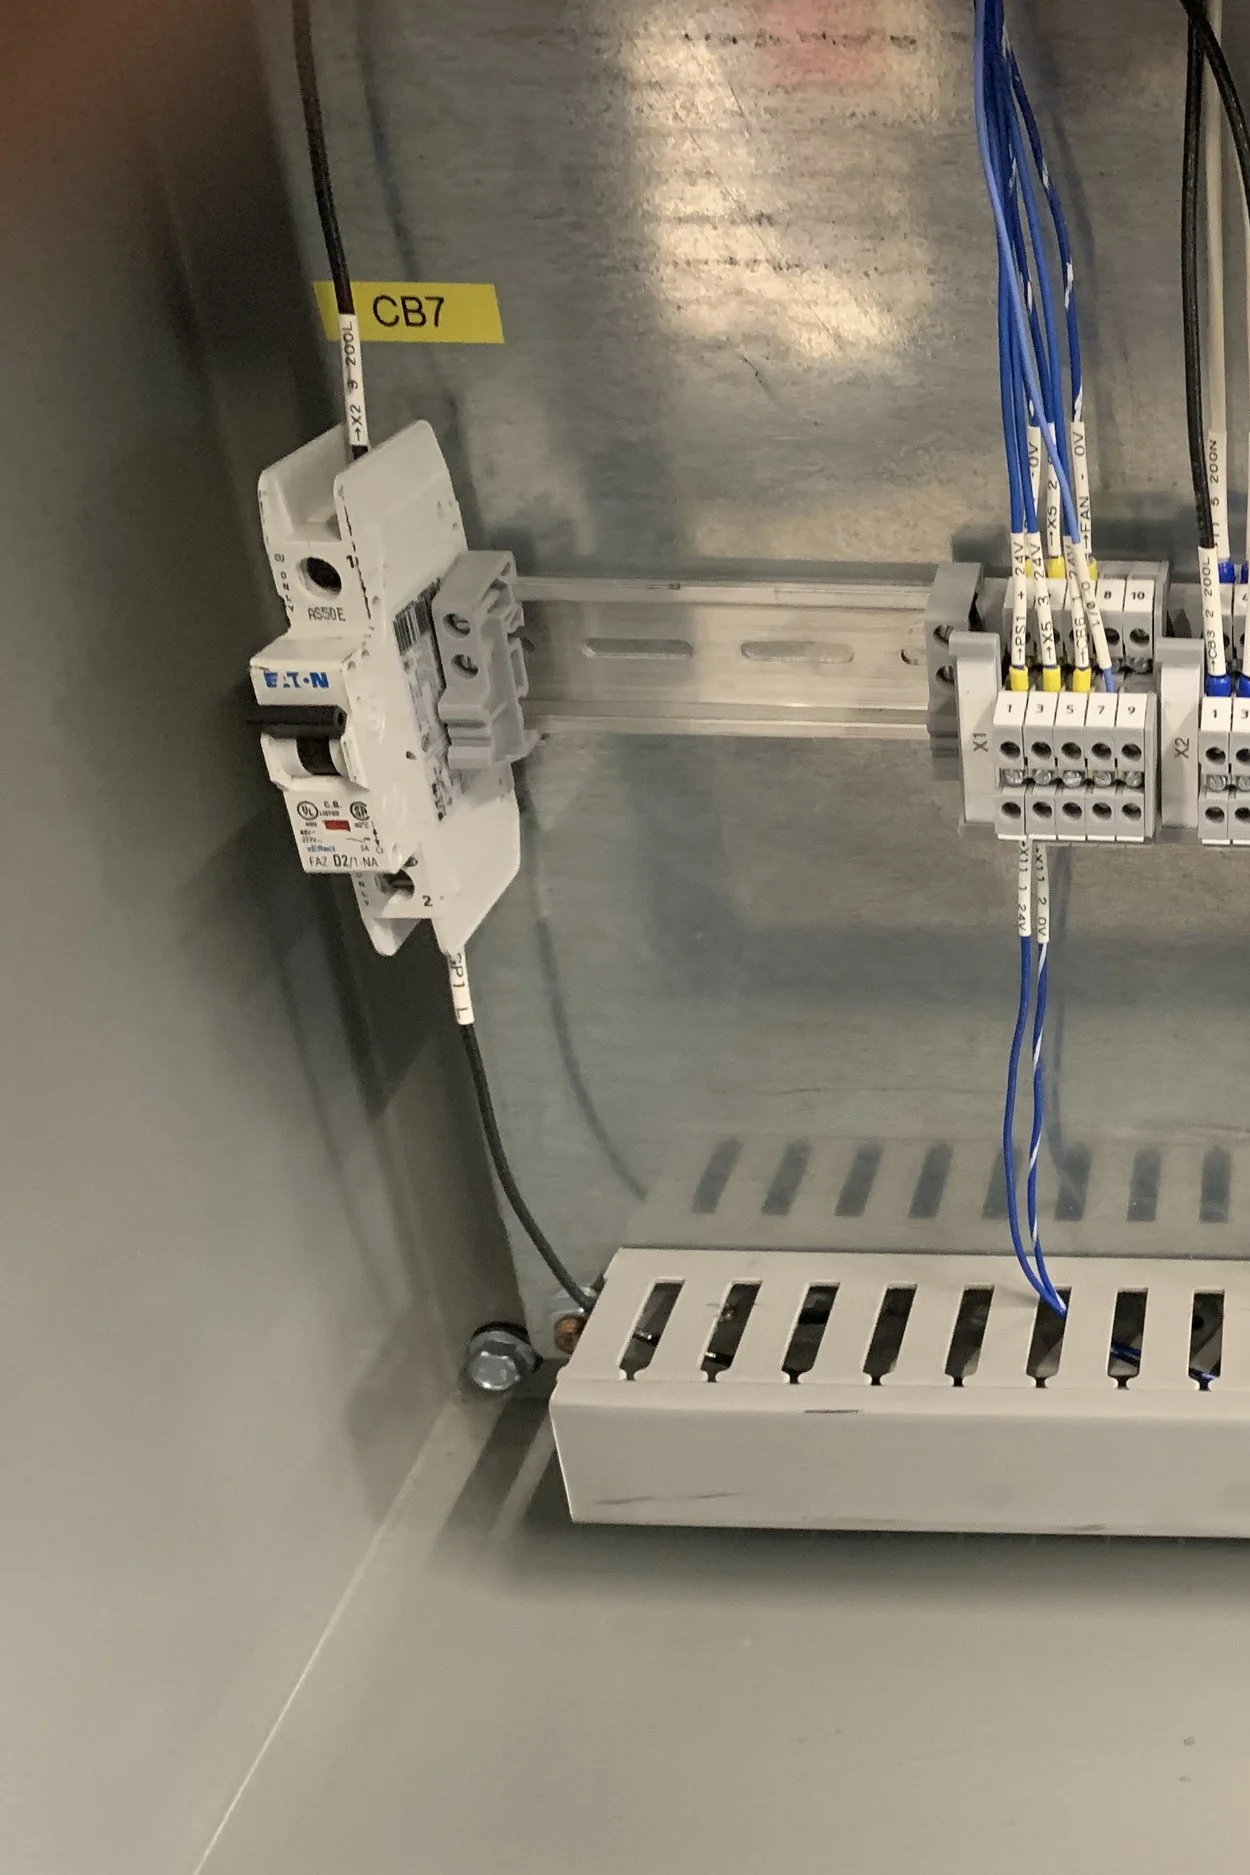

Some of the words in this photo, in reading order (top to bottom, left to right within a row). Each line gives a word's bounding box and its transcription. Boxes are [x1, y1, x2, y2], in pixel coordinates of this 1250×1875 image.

[372, 294, 445, 328] CB7
[342, 320, 357, 366] 200L
[350, 404, 362, 427] X2
[1072, 431, 1085, 457] 0V
[1208, 439, 1219, 484] 200N
[1048, 479, 1057, 490] 2
[1048, 506, 1058, 529] X5
[1079, 495, 1090, 533] FAN
[274, 553, 285, 563] CU
[346, 555, 355, 568] 1
[1014, 542, 1025, 576] 24V
[1030, 543, 1045, 580] 24V
[1202, 557, 1213, 597] 200L
[280, 571, 294, 613] ONLY
[1037, 595, 1049, 606] 3
[1104, 591, 1112, 600] 8
[1131, 591, 1145, 600] 10
[1205, 609, 1214, 617] 2
[1015, 616, 1025, 646] PS1
[1040, 621, 1053, 644] X5
[1207, 630, 1218, 659] CB3
[1007, 703, 1012, 713] 1
[1035, 704, 1044, 714] 3
[1066, 704, 1074, 715] 5
[1097, 705, 1105, 715] 7
[1127, 705, 1136, 715] 9
[1212, 709, 1217, 719] 1
[1240, 709, 1249, 719] 3
[973, 733, 988, 752] X1
[1174, 737, 1190, 759] X2
[1018, 847, 1029, 872] X11
[422, 895, 433, 907] 2
[1038, 897, 1047, 906] 2
[1018, 903, 1027, 931] 24V
[456, 1007, 469, 1020] L
